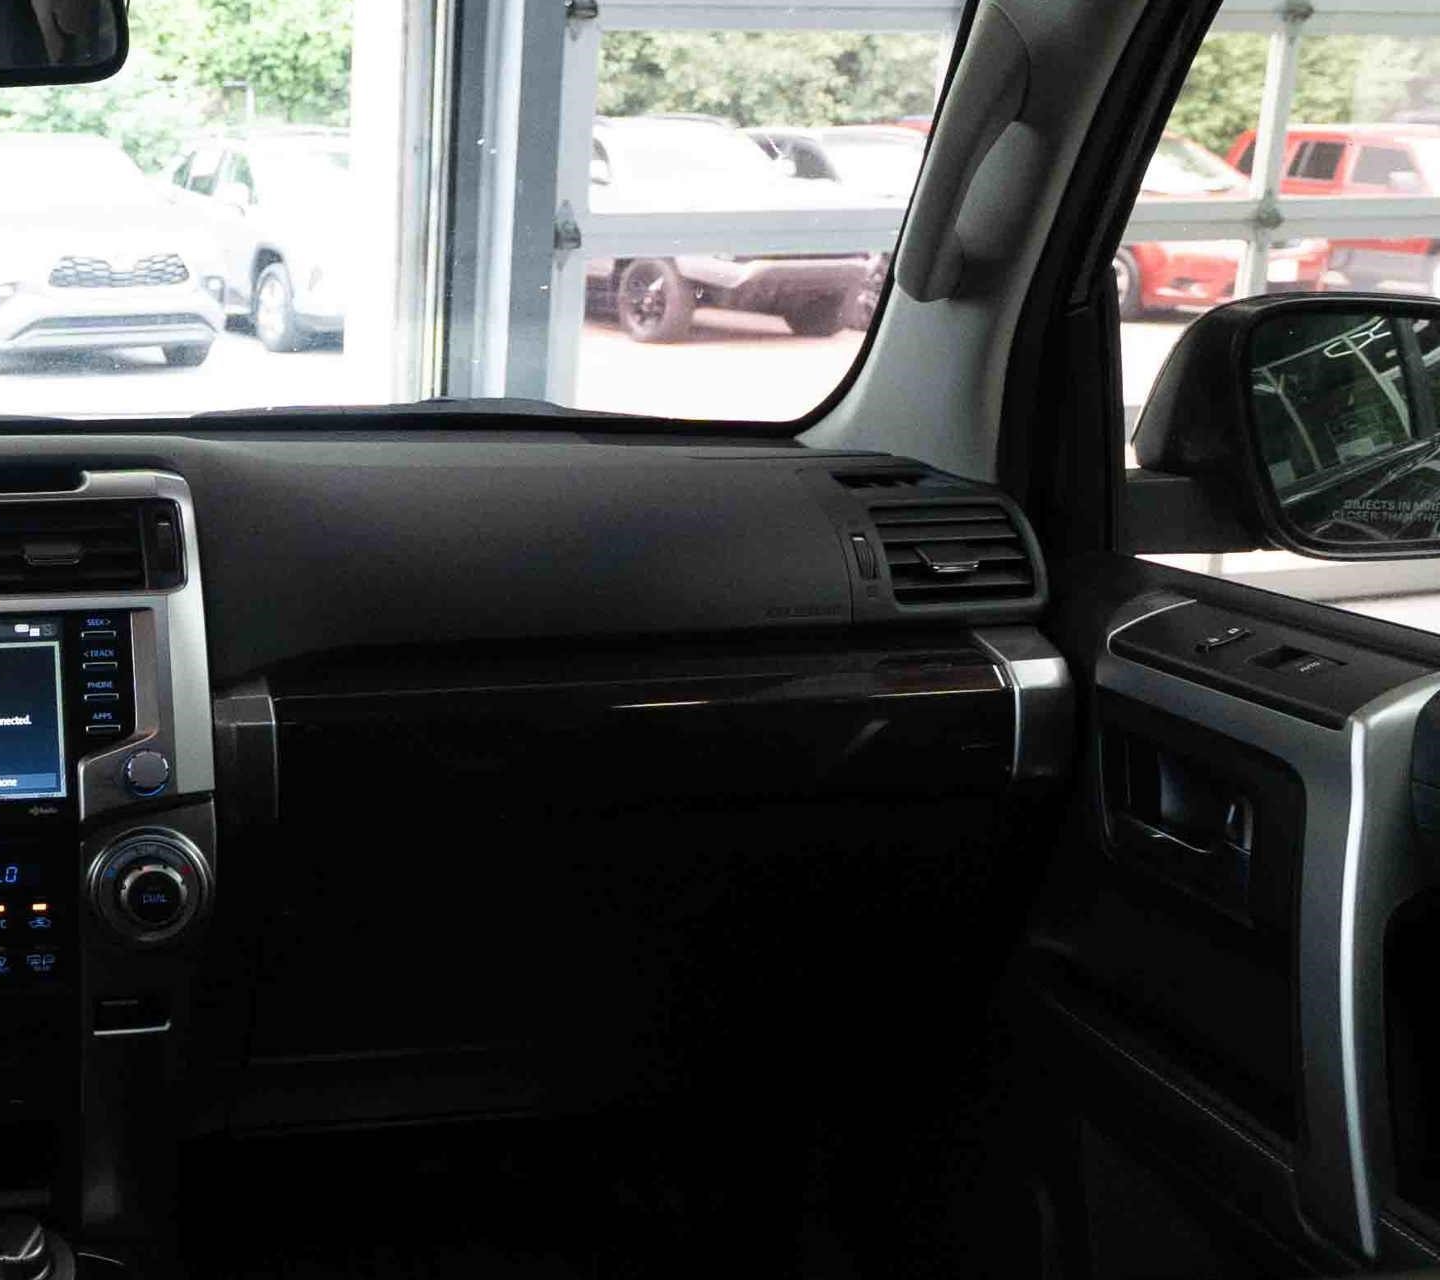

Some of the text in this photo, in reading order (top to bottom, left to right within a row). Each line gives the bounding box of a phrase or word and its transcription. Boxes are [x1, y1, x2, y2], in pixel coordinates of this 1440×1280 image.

[1343, 499, 1394, 511] OBJECTS
[1397, 500, 1411, 511] IN
[87, 681, 113, 689] PHONE
[91, 712, 113, 720] APPS
